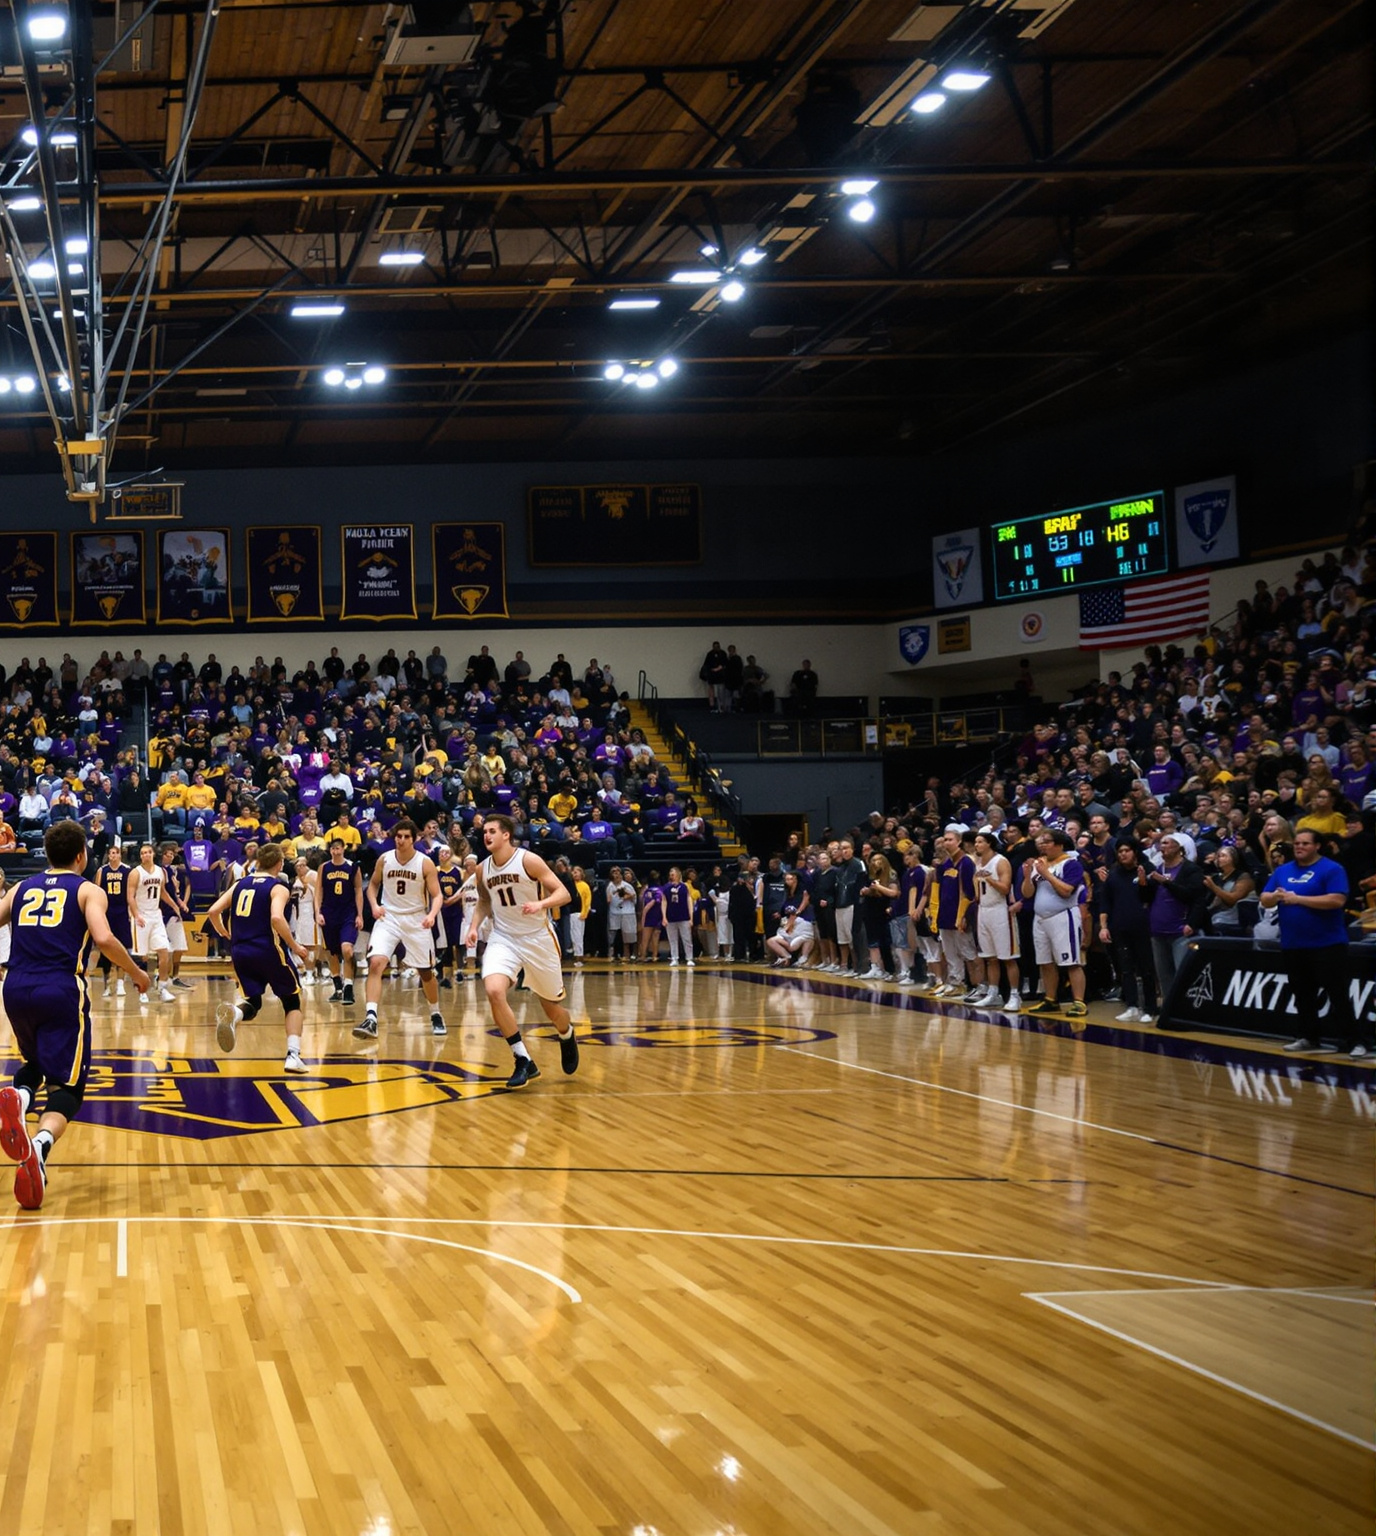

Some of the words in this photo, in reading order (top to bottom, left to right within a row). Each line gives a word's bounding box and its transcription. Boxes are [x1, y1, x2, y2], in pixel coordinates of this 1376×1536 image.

[18, 887, 68, 928] 23
[235, 889, 256, 917] 0
[497, 886, 517, 907] 11
